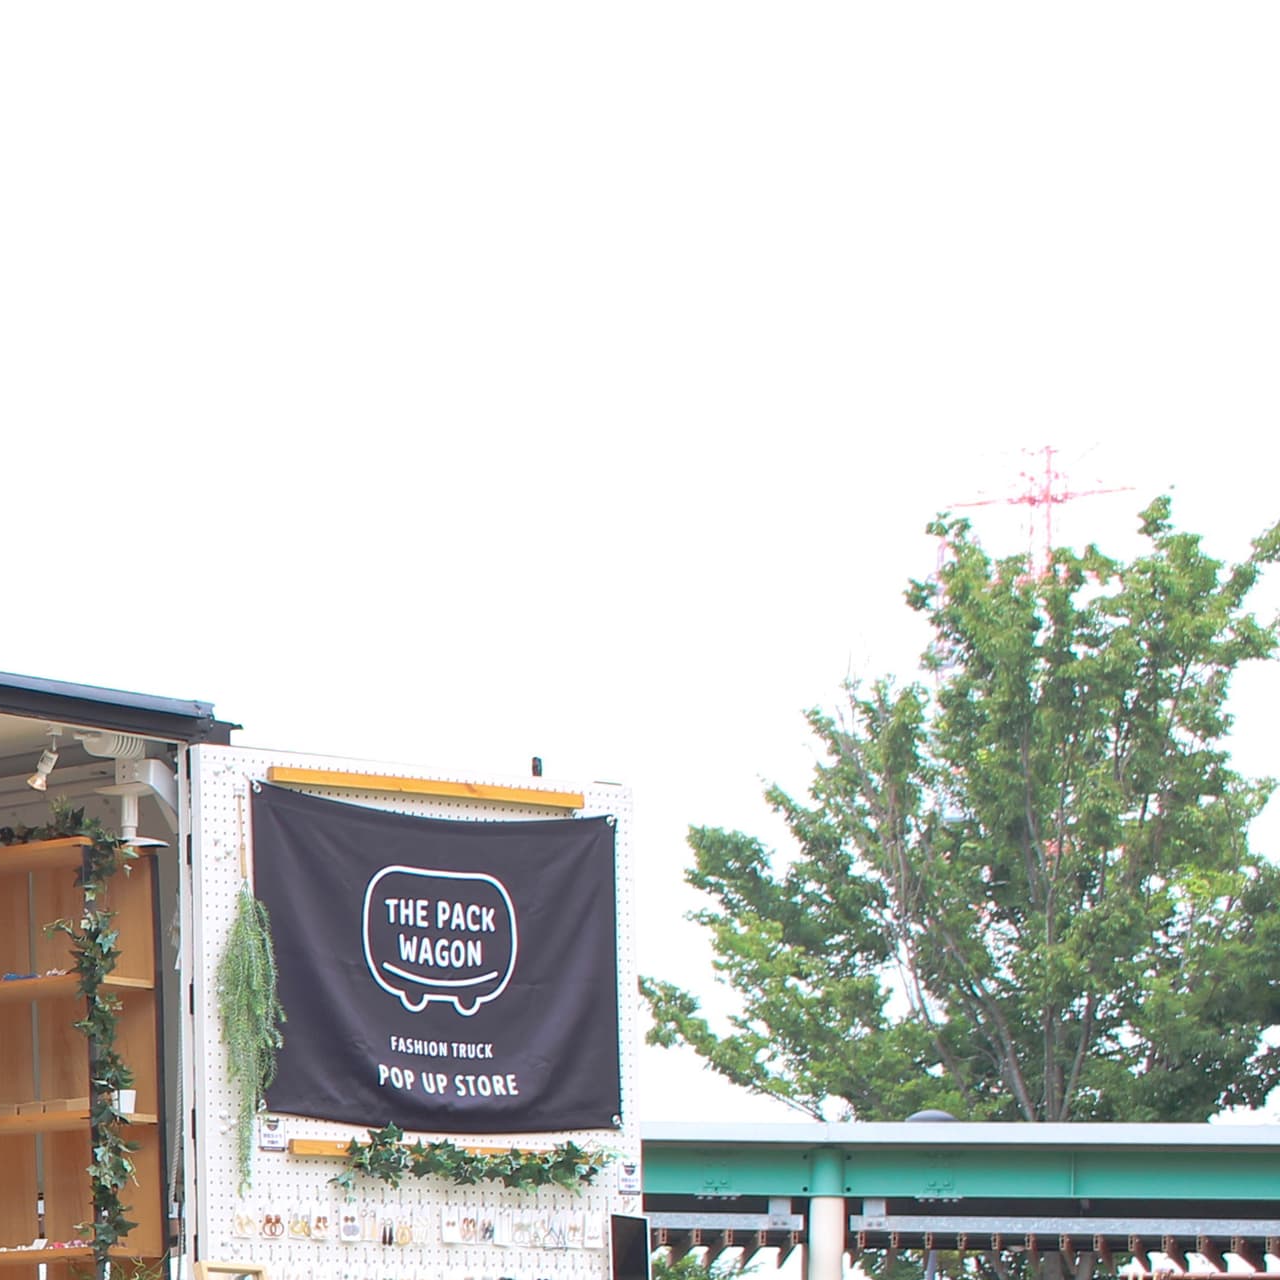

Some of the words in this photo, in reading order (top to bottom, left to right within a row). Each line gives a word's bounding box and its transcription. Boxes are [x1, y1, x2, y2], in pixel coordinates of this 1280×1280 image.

[384, 898, 429, 928] THE
[437, 900, 496, 932] PACK
[399, 933, 482, 968] WAGON
[390, 1035, 448, 1057] FASHION
[451, 1042, 493, 1059] TRUCK
[378, 1063, 415, 1091] POP
[421, 1071, 448, 1095] UP
[454, 1074, 519, 1097] STORE
